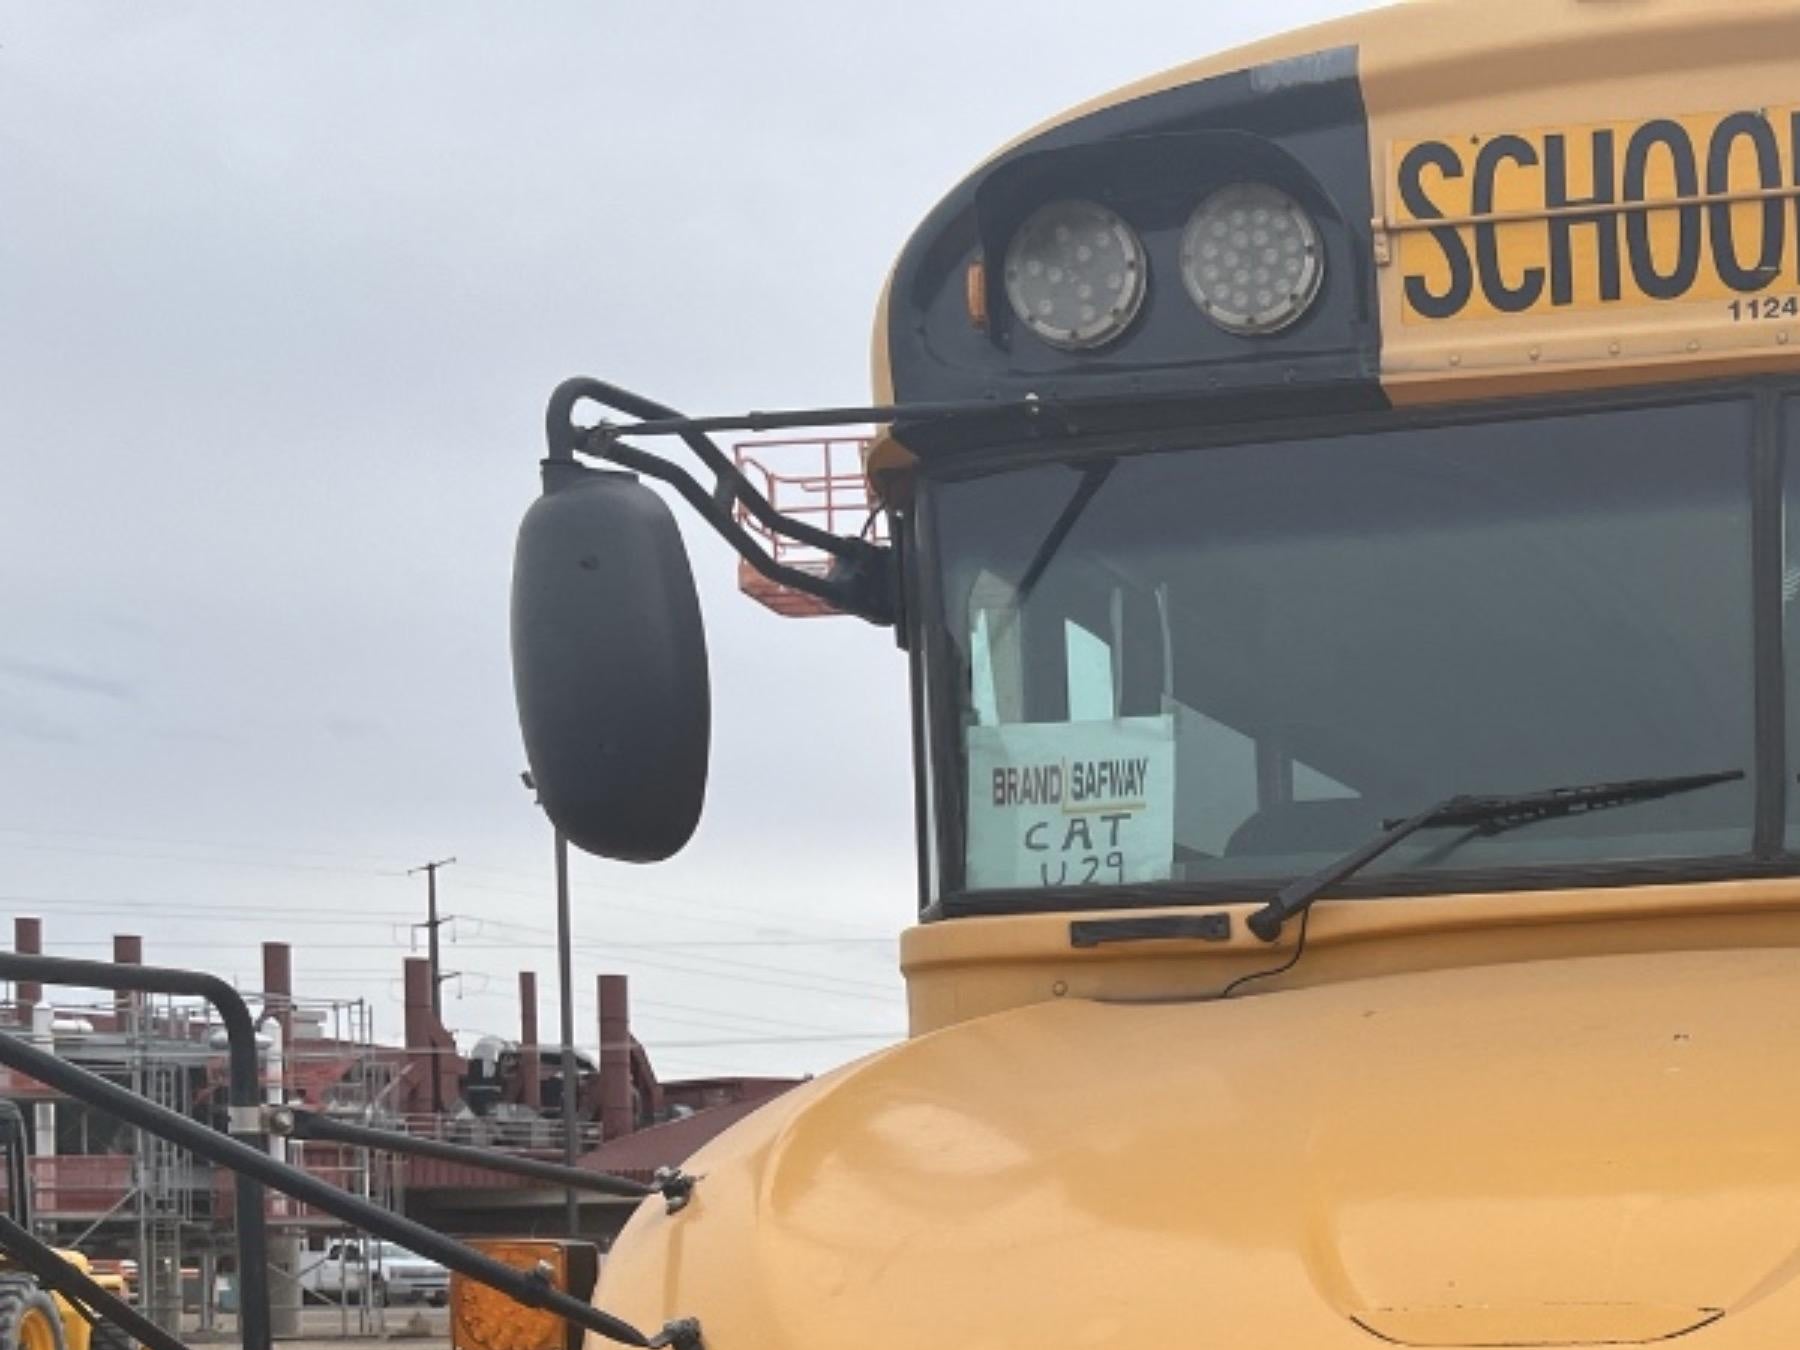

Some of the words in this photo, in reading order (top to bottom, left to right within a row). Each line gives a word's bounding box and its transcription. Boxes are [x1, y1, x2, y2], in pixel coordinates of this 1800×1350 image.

[1727, 296, 1800, 323] 1124
[992, 765, 1061, 806] BRAND
[1070, 757, 1149, 801] SAFWAY
[1025, 813, 1132, 852] CAT
